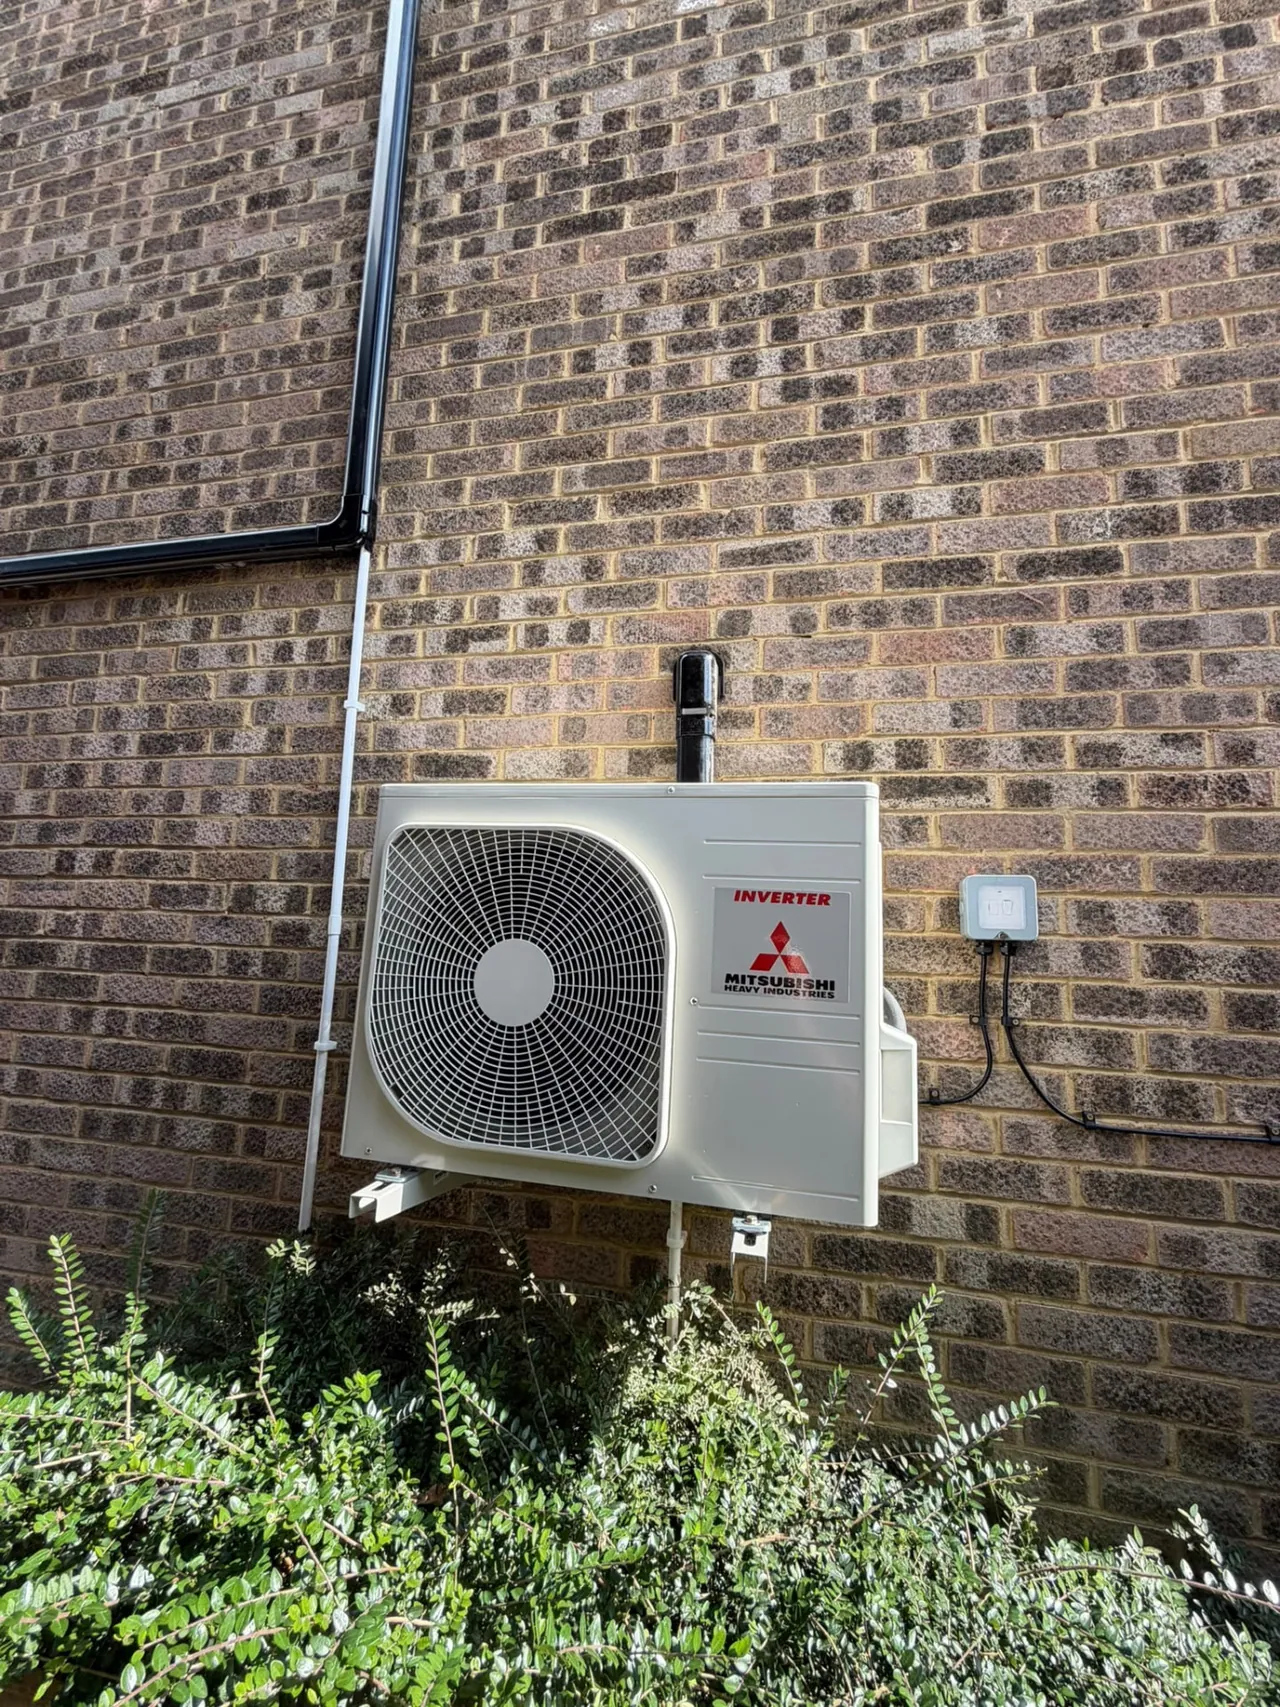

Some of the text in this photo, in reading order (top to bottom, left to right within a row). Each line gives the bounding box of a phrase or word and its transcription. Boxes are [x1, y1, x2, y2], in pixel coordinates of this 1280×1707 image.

[734, 890, 831, 906] INVERTER
[725, 973, 835, 991] MITSUBISHI
[724, 985, 835, 999] HEAVY INDUSTRIES
